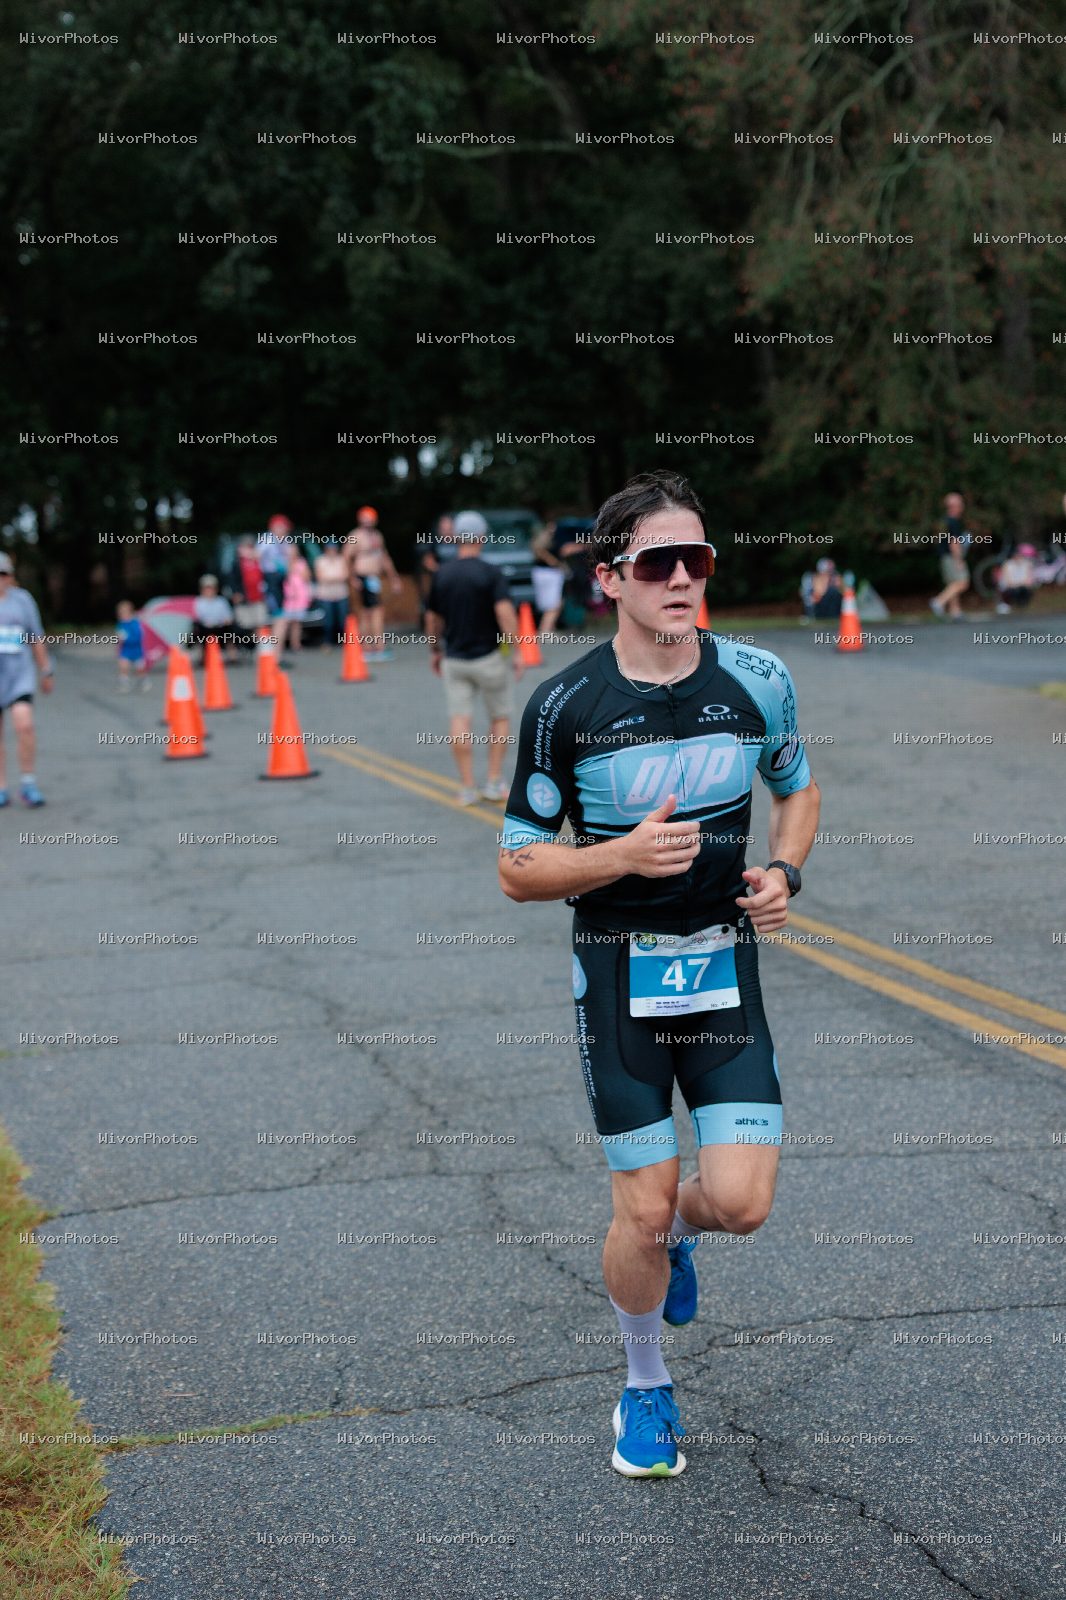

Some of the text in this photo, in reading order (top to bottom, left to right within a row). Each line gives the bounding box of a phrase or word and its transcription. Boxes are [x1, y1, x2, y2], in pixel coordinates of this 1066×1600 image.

[534, 682, 565, 768] Midwest Center
[543, 676, 590, 771] for Joint Replacement
[698, 714, 739, 723] OAKLEY
[661, 957, 712, 992] 47
[586, 1058, 597, 1098] Center
